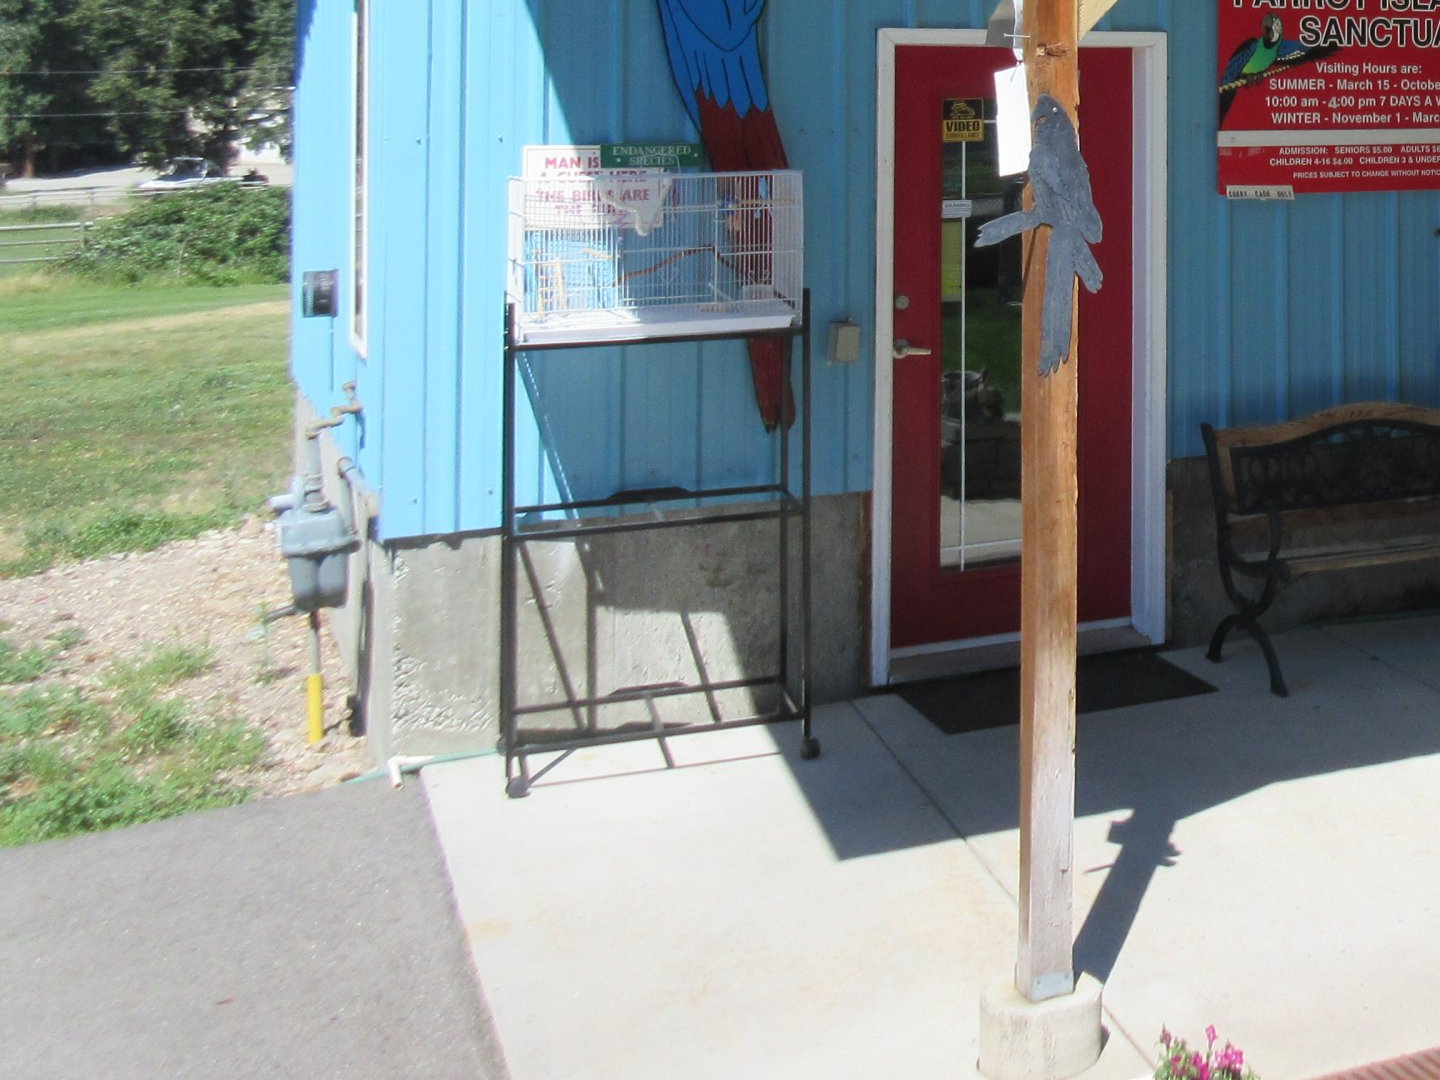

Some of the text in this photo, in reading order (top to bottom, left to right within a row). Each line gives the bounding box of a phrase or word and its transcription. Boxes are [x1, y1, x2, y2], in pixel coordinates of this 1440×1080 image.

[1316, 62, 1422, 76] Visiting Hours are:
[1269, 79, 1325, 90] SUMMER
[1336, 79, 1373, 90] March
[1377, 79, 1390, 90] 15
[1265, 96, 1298, 107] 10:00
[1300, 98, 1319, 107] am
[1328, 96, 1355, 109] 4:00
[1358, 98, 1376, 109] pm
[1379, 96, 1386, 107] 7
[1389, 96, 1421, 107] DAYS
[1424, 96, 1432, 107] A
[1271, 113, 1321, 124] WINTER
[1332, 113, 1392, 124] November
[1394, 113, 1401, 123] 1
[946, 120, 980, 132] VIDEO
[612, 145, 692, 156] ENDANGERED
[1279, 146, 1328, 155] ADMISSION:
[1334, 146, 1370, 155] SENIORS
[1372, 145, 1393, 154] $5.00
[1401, 145, 1430, 153] ADULTS
[544, 156, 600, 169] MAN IS
[629, 155, 675, 166] SPECIES
[1269, 158, 1312, 166] CHILDREN
[1313, 157, 1331, 165] 4-16
[1359, 156, 1400, 164] CHILDREN
[1401, 156, 1407, 164] 3
[1293, 171, 1318, 179] PRICES
[1391, 169, 1420, 177] WITHOUT
